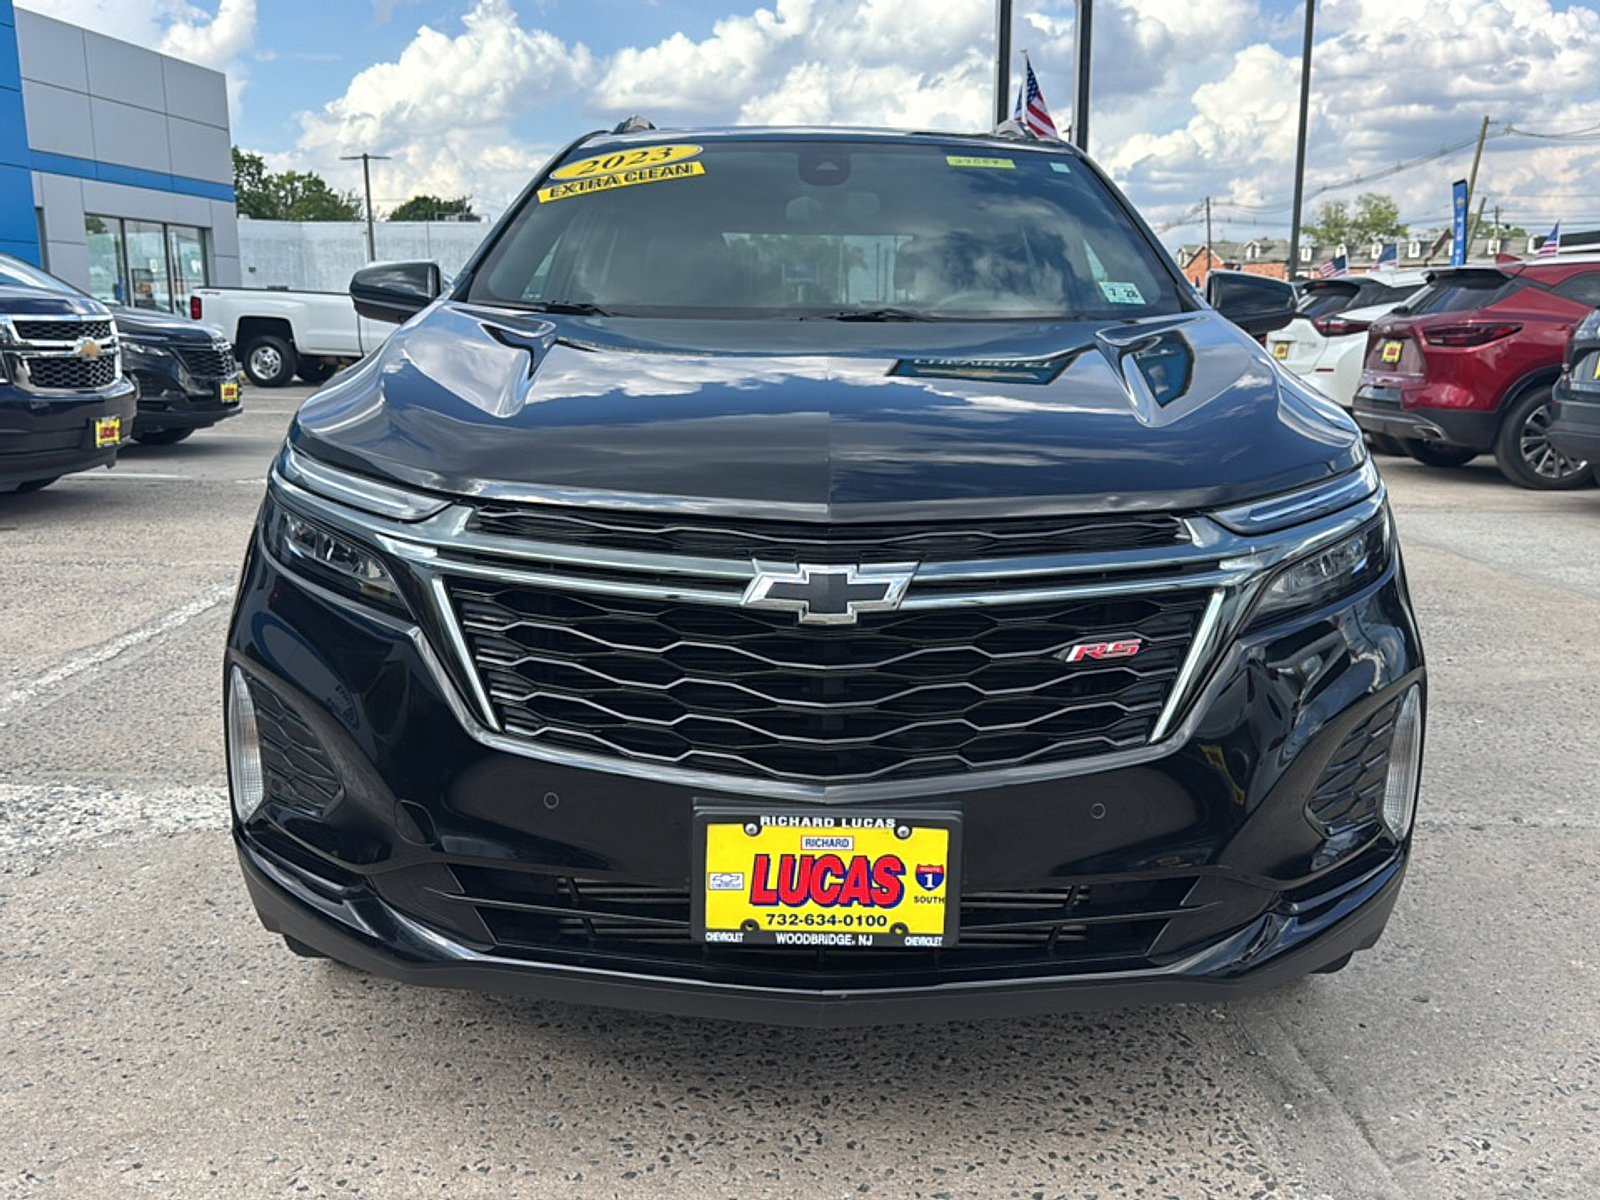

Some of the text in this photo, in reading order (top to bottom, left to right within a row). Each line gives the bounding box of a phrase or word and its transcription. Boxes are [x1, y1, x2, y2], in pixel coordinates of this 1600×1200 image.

[580, 147, 673, 175] 2023
[550, 163, 694, 198] EXTRA CLEAN
[1066, 639, 1142, 662] RS
[760, 816, 896, 829] RICHARD LUCAS
[805, 838, 850, 848] RICHARD
[749, 853, 906, 909] LUCAS
[924, 873, 935, 888] 1
[914, 895, 946, 904] SOUTH
[766, 913, 888, 928] 732-634-0100
[858, 935, 873, 946] NJ
